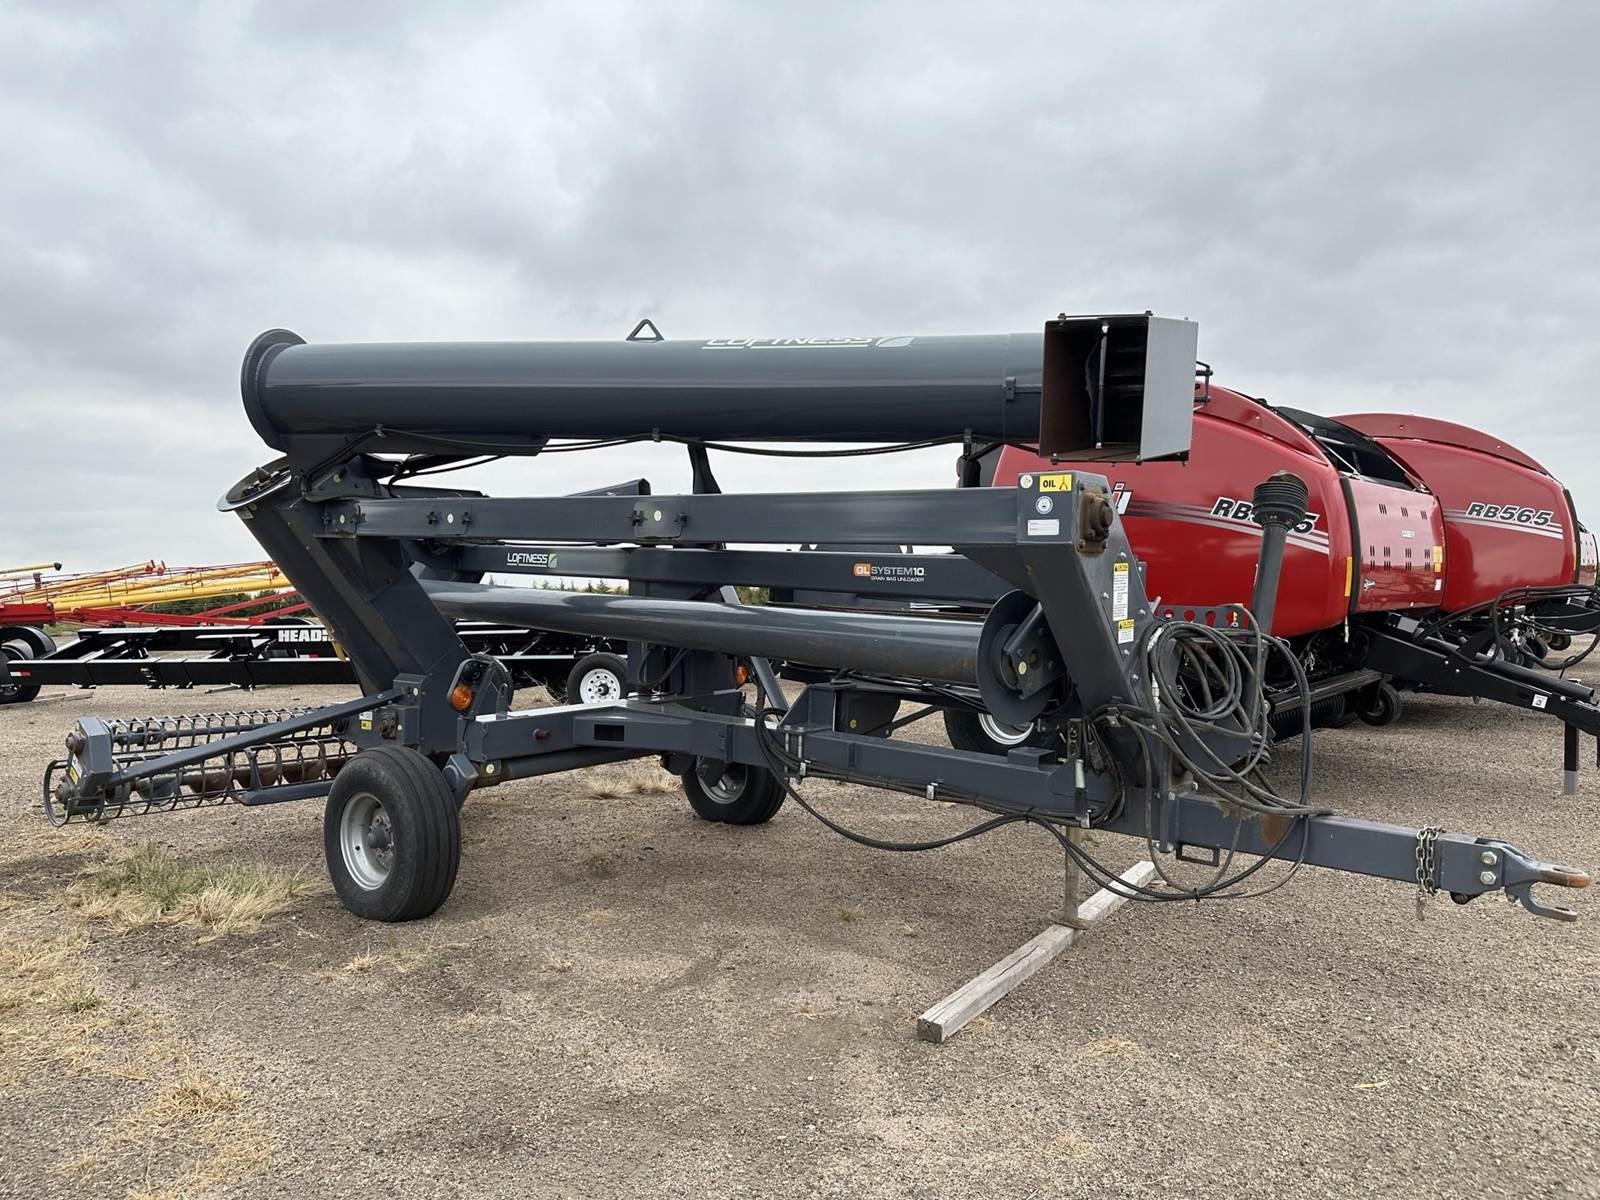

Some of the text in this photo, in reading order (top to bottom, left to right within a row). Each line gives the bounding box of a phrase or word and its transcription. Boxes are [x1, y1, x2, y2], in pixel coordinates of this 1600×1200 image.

[1042, 480, 1056, 488] OIL
[1465, 502, 1554, 526] RB565
[507, 553, 548, 564] LOFTNESS
